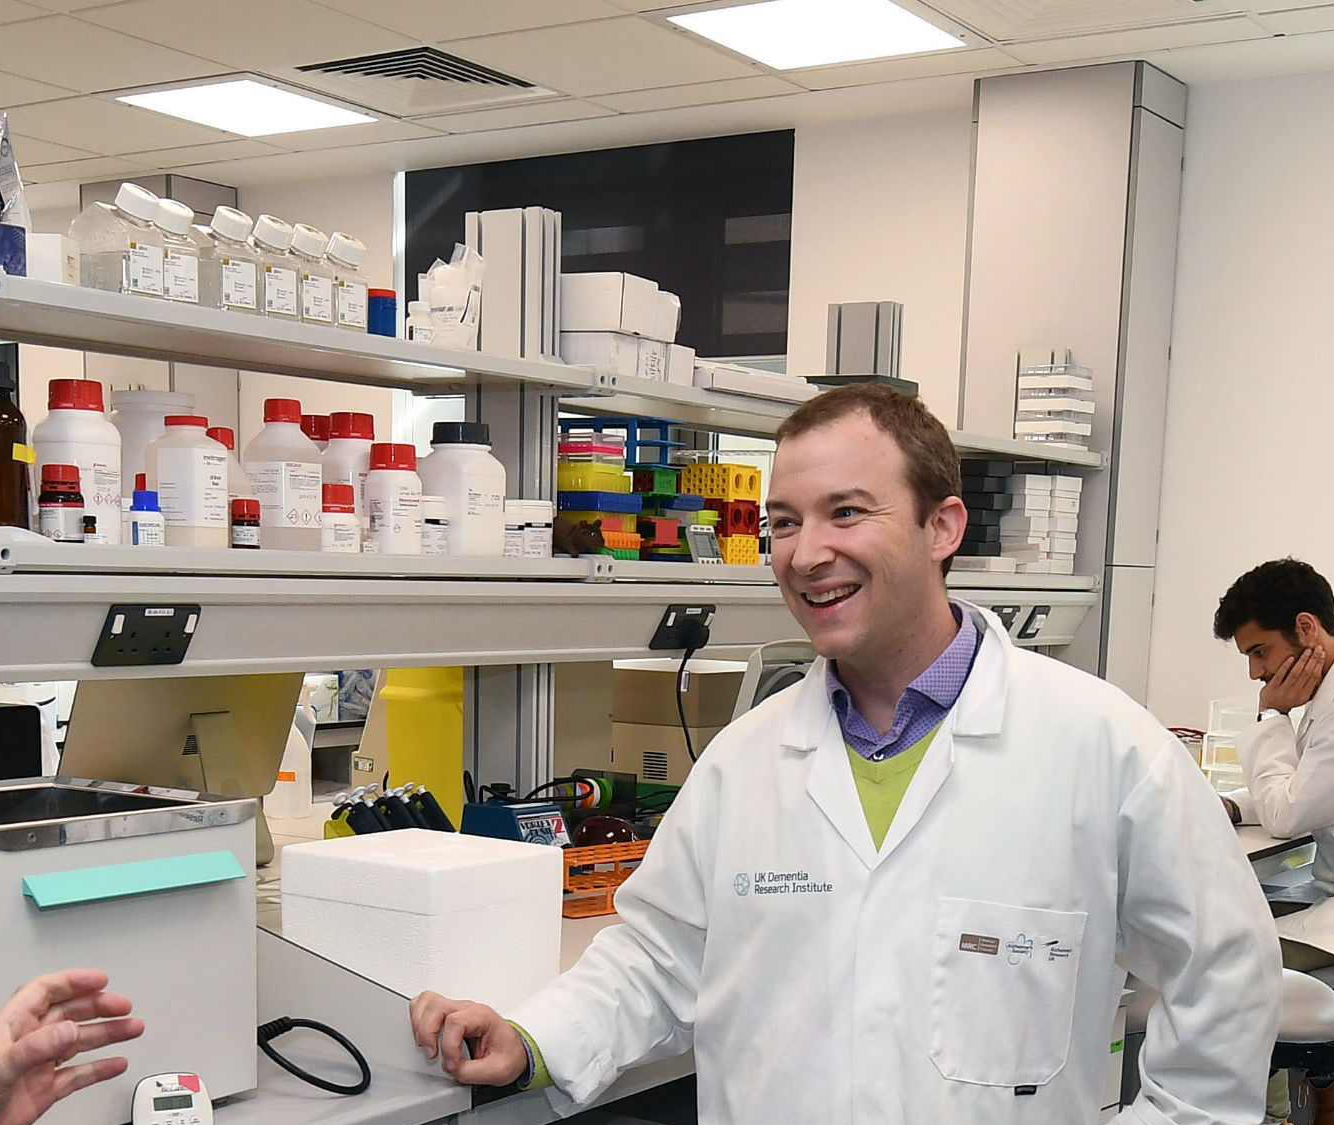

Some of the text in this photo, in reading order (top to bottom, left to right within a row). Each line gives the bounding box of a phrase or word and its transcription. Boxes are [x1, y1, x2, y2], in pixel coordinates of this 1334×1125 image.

[754, 870, 809, 883] UK Dementia
[754, 882, 833, 895] Research Institute
